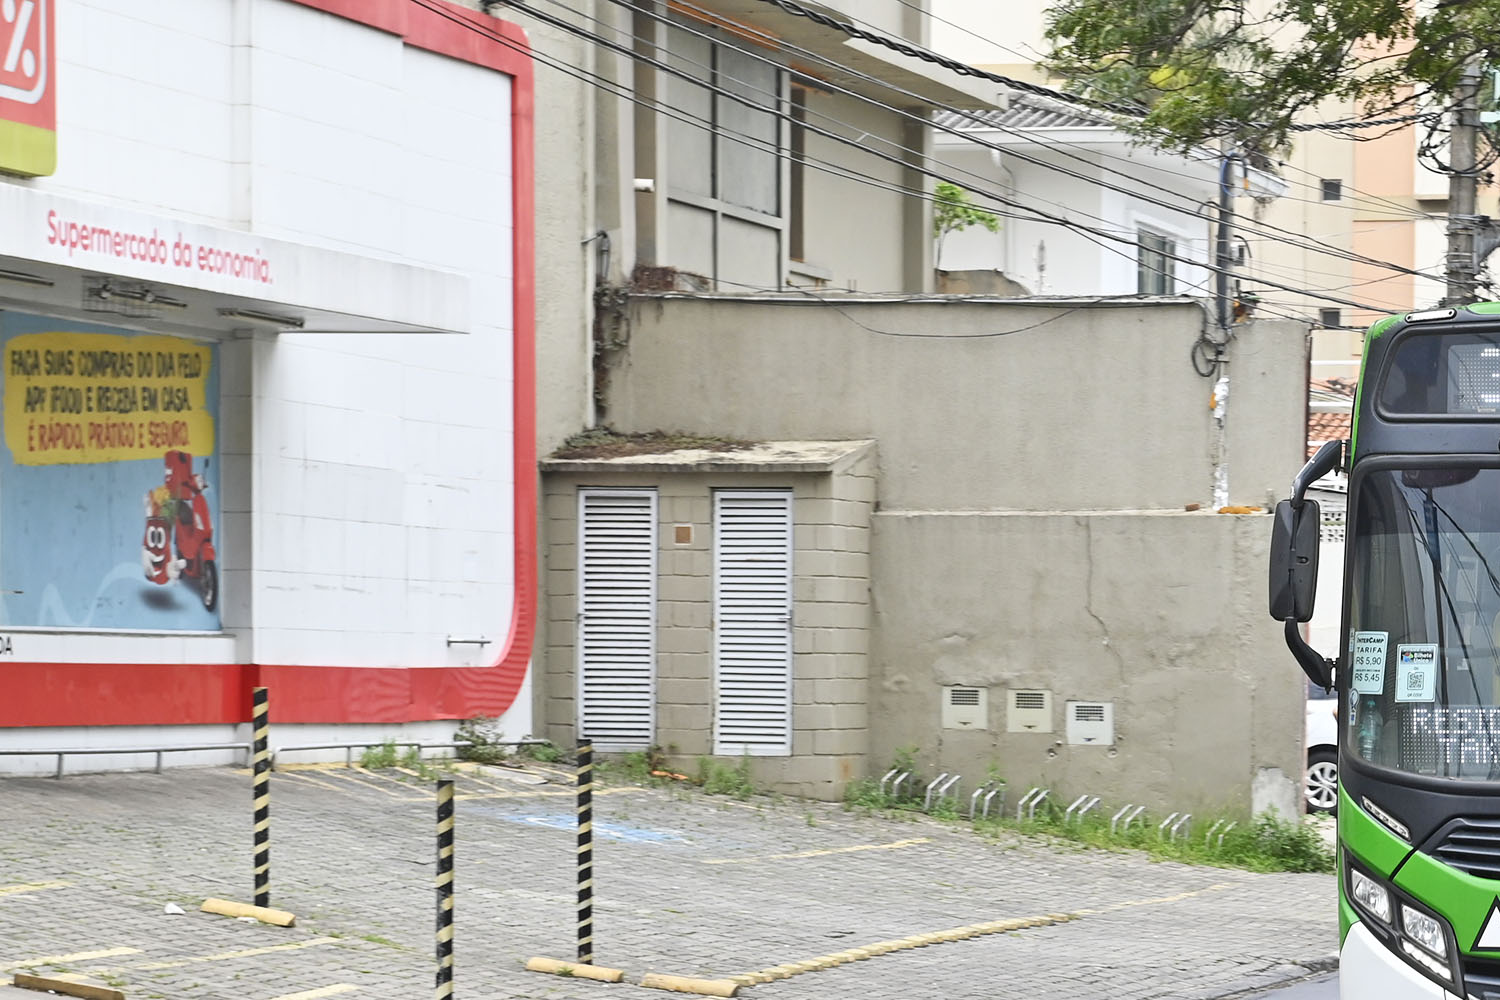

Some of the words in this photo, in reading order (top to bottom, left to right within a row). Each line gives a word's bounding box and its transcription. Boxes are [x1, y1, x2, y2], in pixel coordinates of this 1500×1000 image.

[47, 209, 168, 265] Supermercado
[172, 232, 193, 267] da
[199, 246, 273, 284] economia.
[11, 350, 41, 381] FAÇA
[45, 349, 74, 376] SUAS
[79, 350, 134, 378] COMPRAS
[137, 351, 154, 378] DO
[156, 352, 176, 378] DIA
[178, 352, 202, 379] PELO
[86, 386, 93, 412] E
[97, 386, 138, 414] RECEBA
[141, 386, 158, 413] EM
[88, 416, 135, 450] PRÁTICO
[139, 422, 145, 449] E
[1356, 656, 1364, 665] R$
[1365, 656, 1381, 666] 5,90
[1354, 673, 1362, 682] R$
[1364, 673, 1380, 682] 5,45
